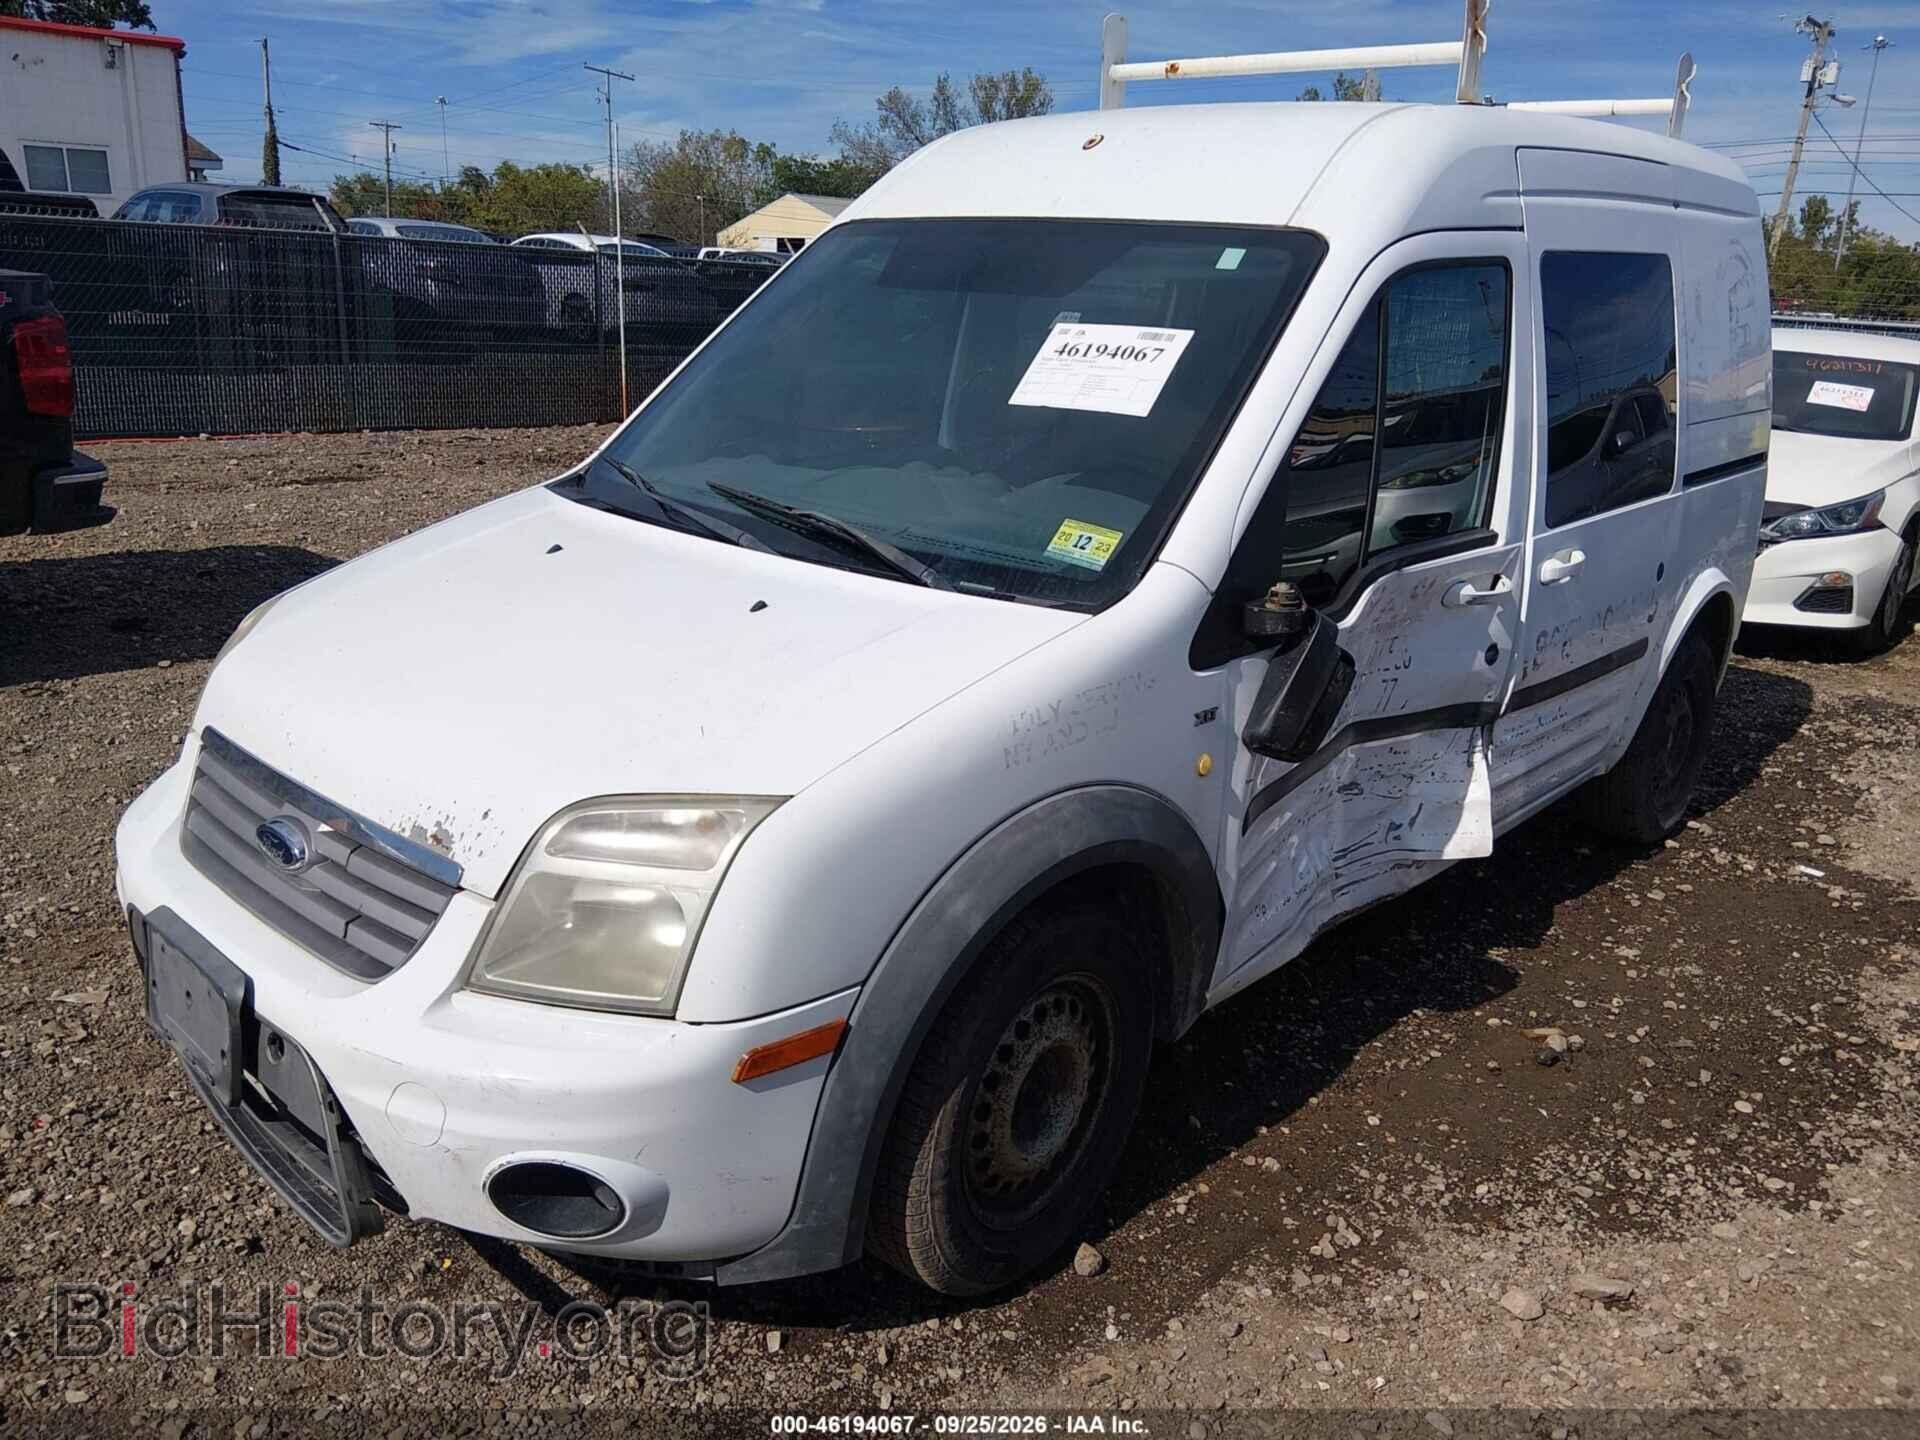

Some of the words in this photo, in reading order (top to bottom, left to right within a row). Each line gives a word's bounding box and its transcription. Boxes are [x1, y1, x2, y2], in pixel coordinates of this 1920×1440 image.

[1053, 341, 1165, 363] 46194067
[1057, 530, 1073, 542] 20
[1072, 534, 1093, 551] 12
[1094, 542, 1112, 553] 23
